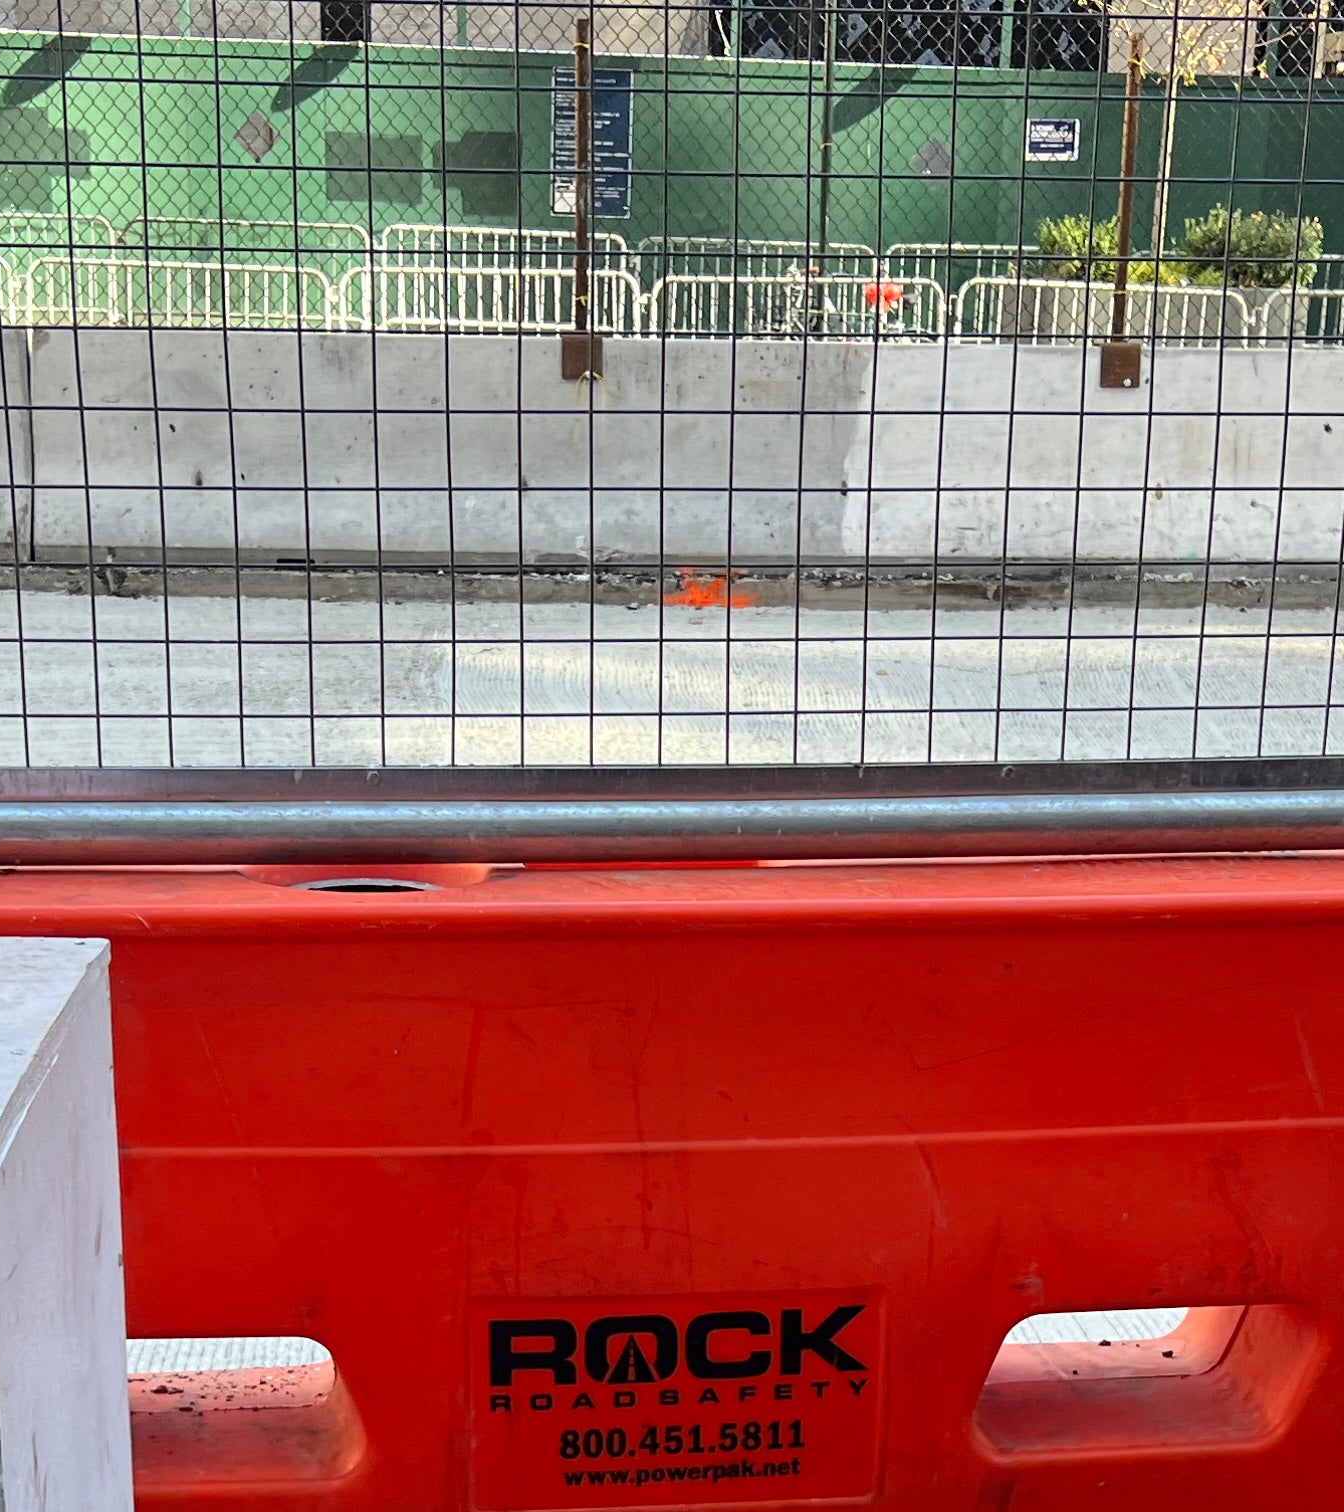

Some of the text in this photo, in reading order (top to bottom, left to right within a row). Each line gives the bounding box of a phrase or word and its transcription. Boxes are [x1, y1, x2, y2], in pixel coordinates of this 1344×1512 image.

[489, 1304, 868, 1387] ROCK
[559, 1419, 806, 1460] 800.451.5811
[563, 1456, 801, 1487] www.powerpak.net
